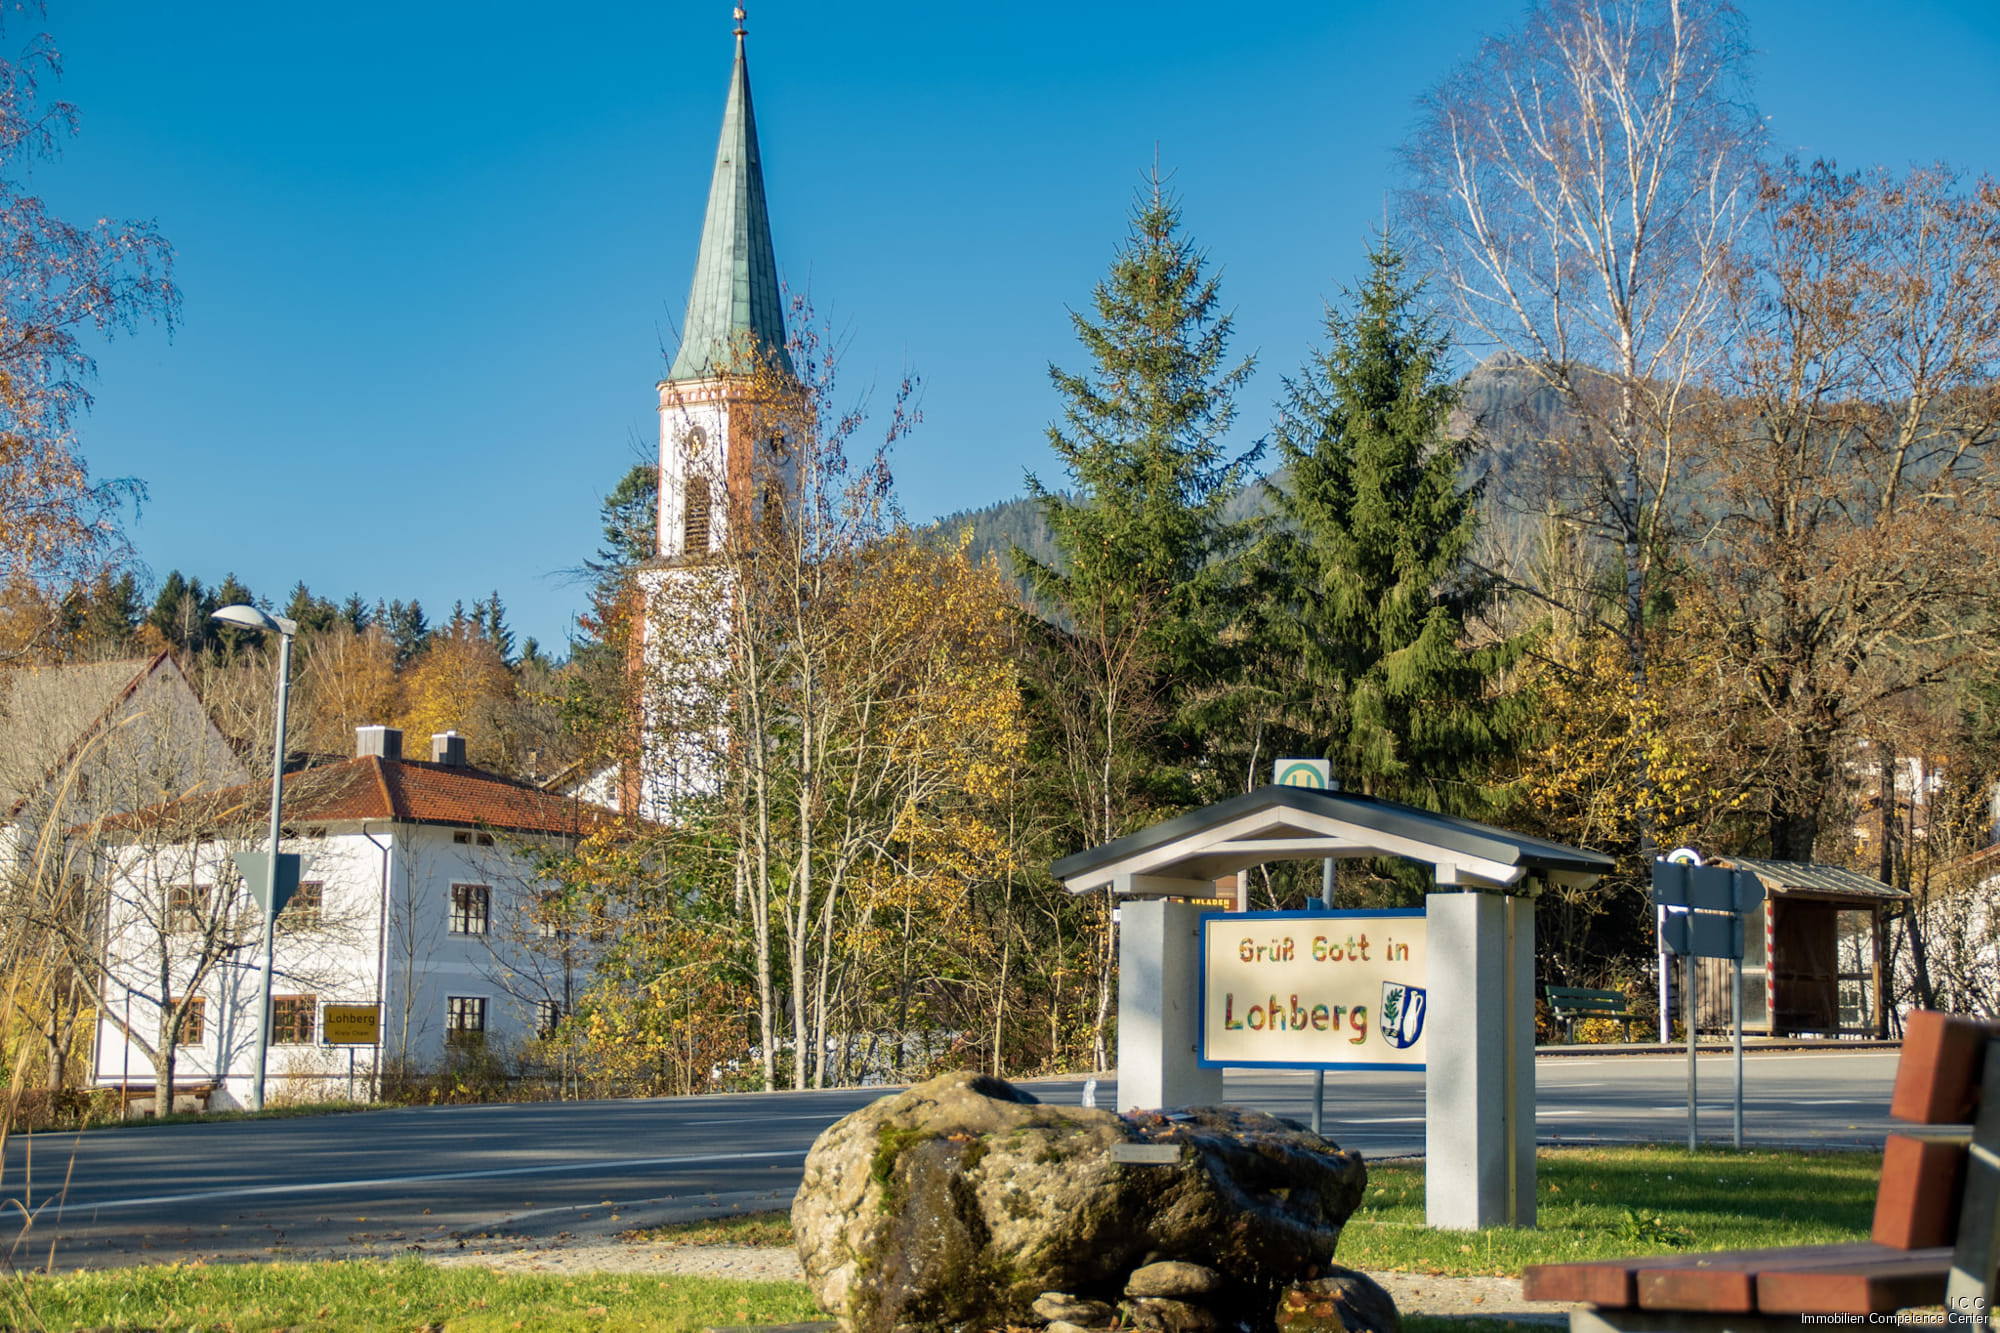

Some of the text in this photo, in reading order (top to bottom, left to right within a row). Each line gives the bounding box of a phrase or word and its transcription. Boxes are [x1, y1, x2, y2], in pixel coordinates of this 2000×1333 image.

[1239, 934, 1409, 962] Grüß Gott in
[328, 1012, 375, 1026] Lohberg
[1225, 993, 1368, 1045] Lohberg
